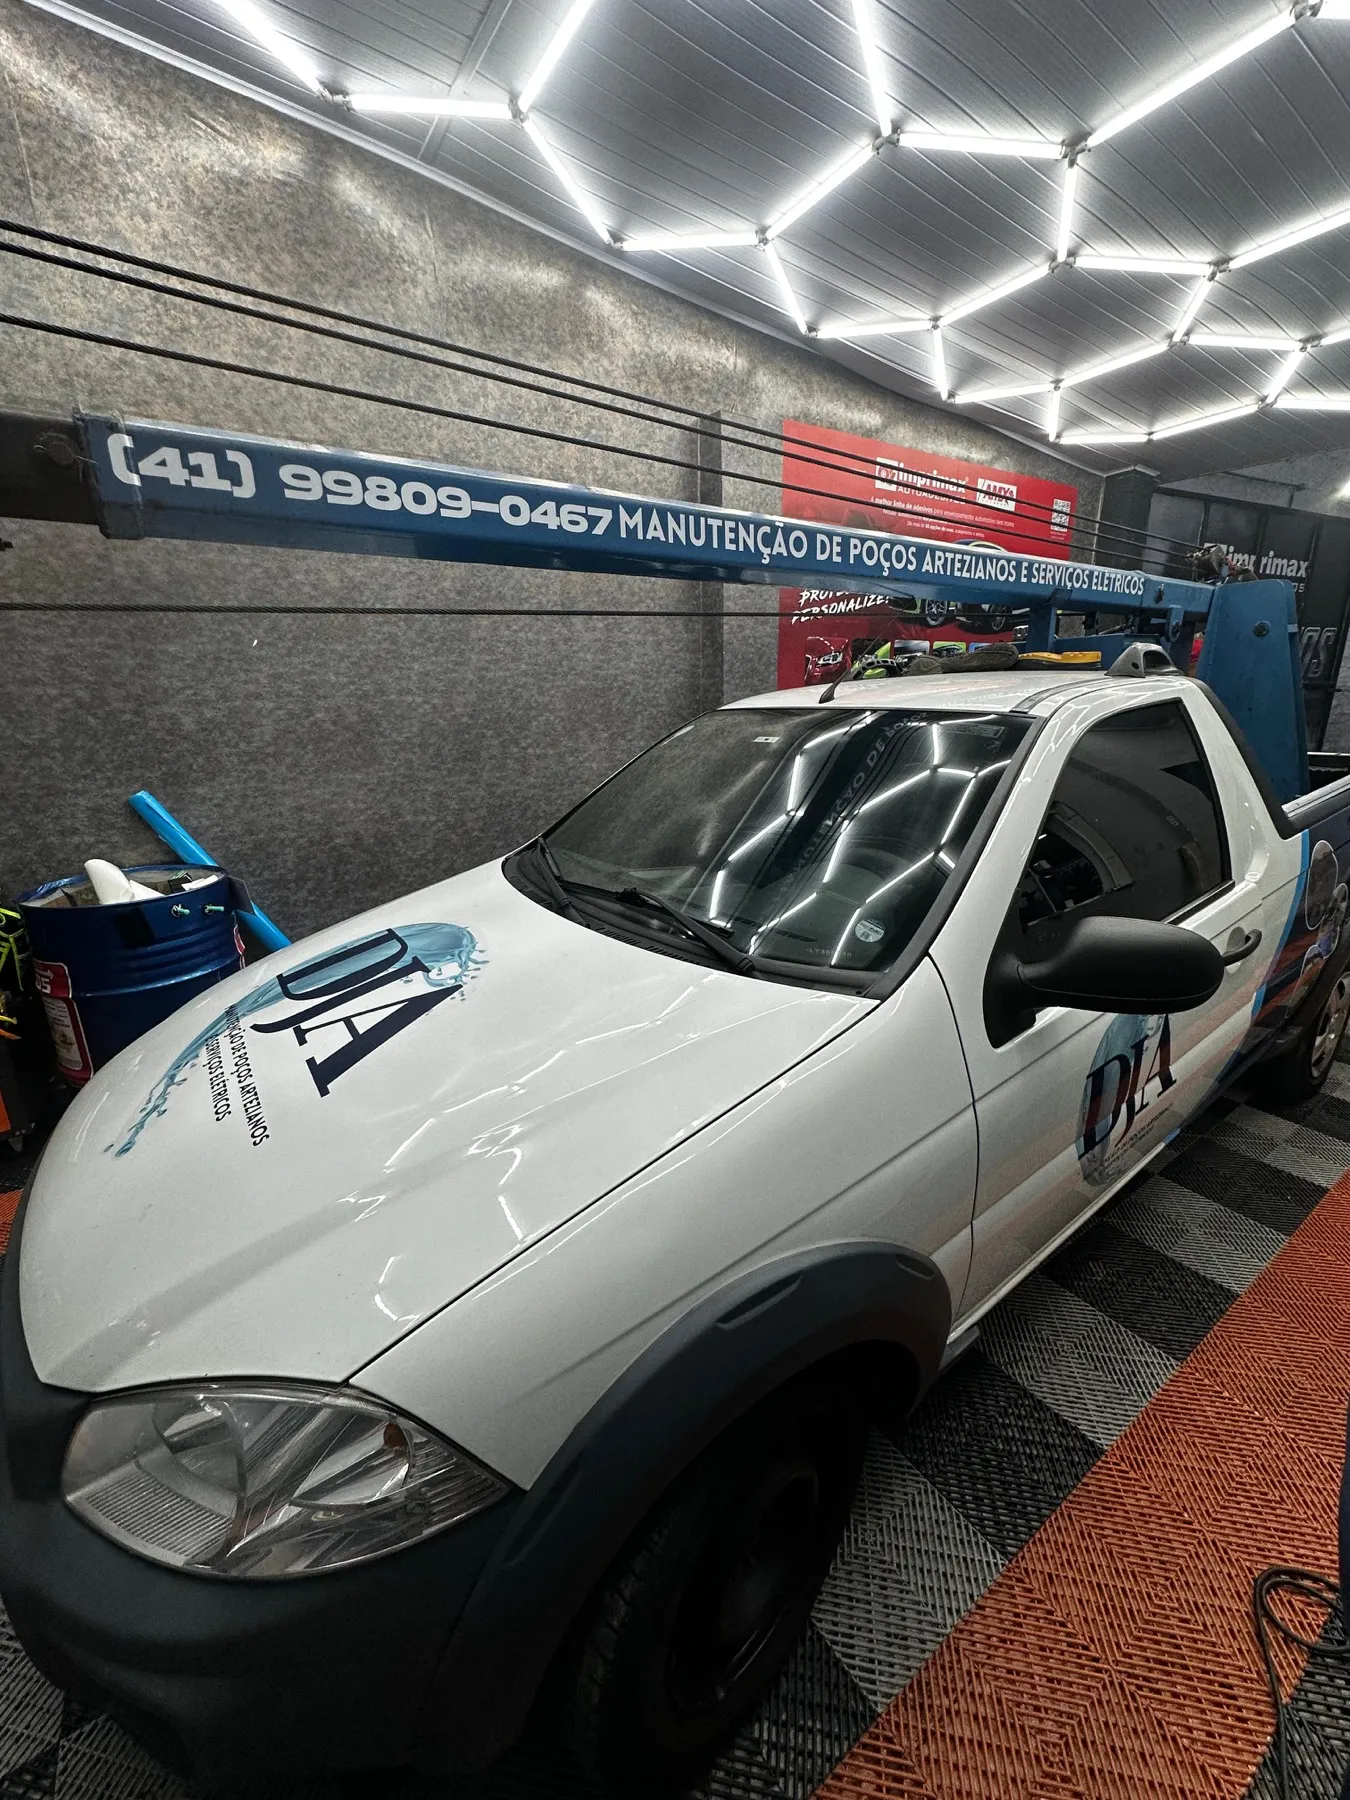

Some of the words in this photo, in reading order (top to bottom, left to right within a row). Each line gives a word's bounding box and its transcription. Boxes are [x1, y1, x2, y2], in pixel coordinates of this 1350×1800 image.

[107, 432, 256, 499] (41)
[278, 463, 613, 537] 99809-0467
[618, 504, 808, 565] MANUTENÇÃO
[816, 533, 842, 563] DE
[849, 537, 917, 576] POÇOS
[921, 549, 1017, 583] ARTEZIANOS
[1020, 561, 1028, 581] E
[1031, 563, 1090, 590] SERVIÇOS
[250, 927, 464, 1098] DJA
[202, 1037, 224, 1075] SERVIÇOS
[230, 1044, 247, 1056] DE
[230, 1051, 253, 1084] POÇOS
[209, 1071, 232, 1122] ELÉTRICOS
[238, 1081, 270, 1147] ARTEZIANOS
